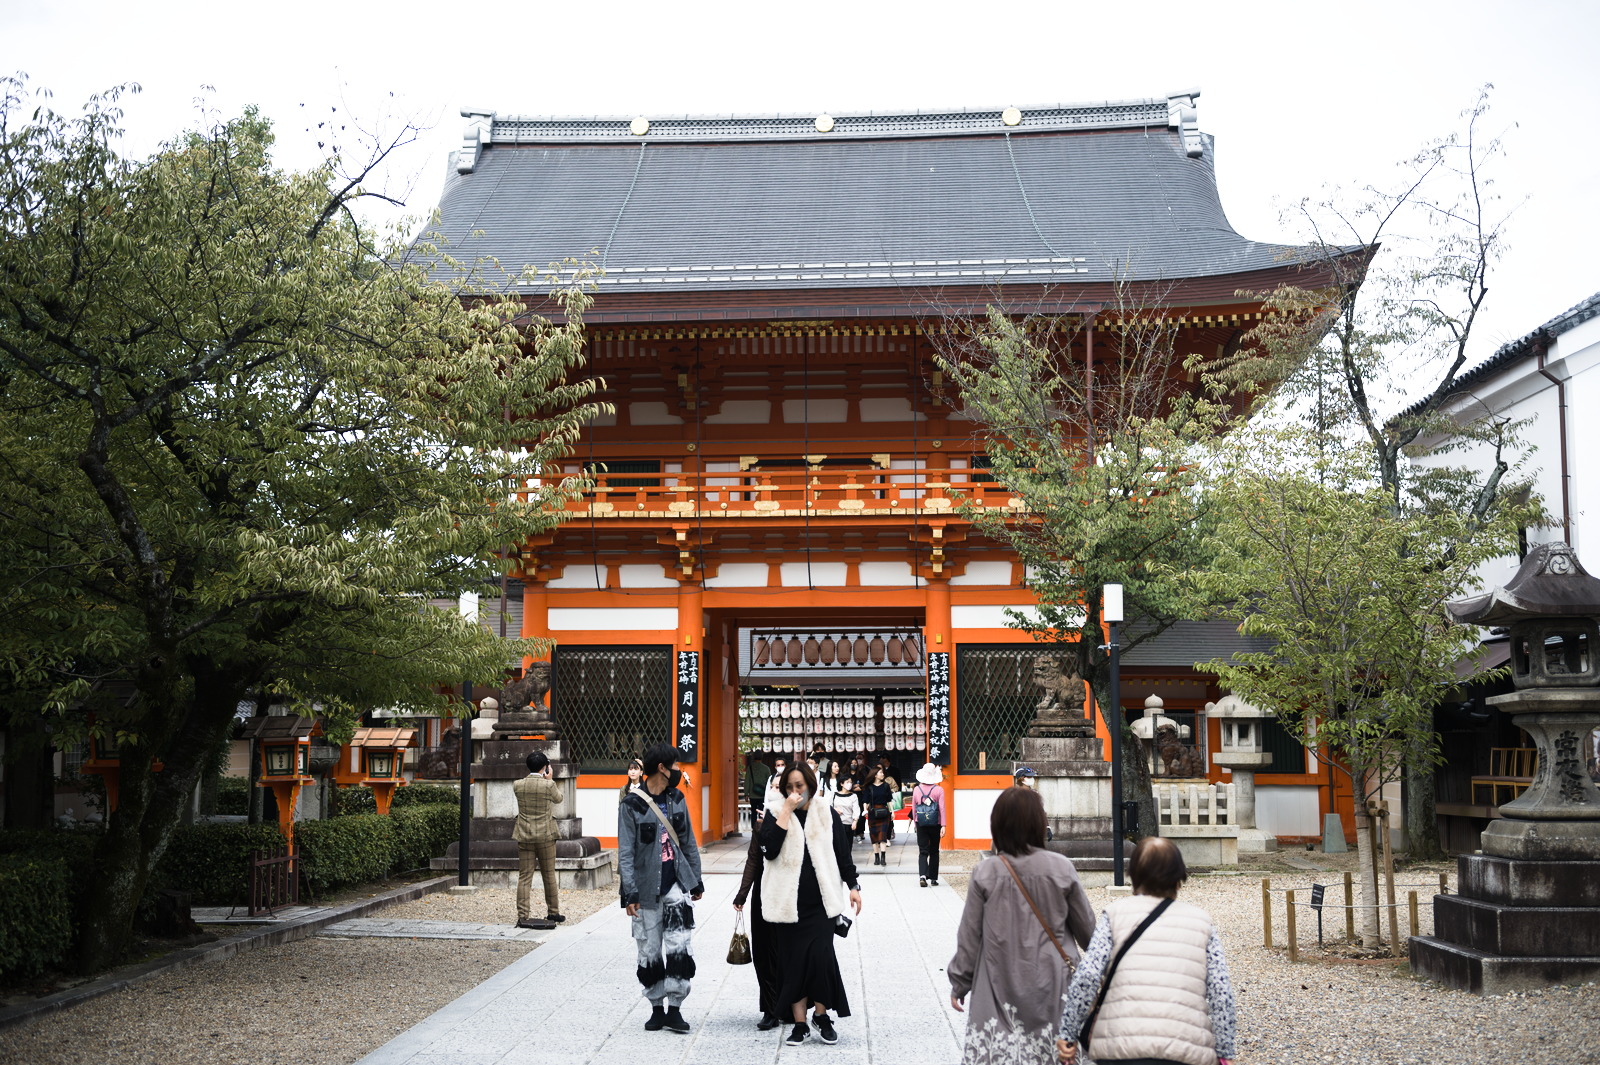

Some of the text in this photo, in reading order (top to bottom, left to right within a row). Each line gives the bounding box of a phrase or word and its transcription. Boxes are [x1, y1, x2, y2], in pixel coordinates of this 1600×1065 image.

[678, 651, 689, 685] 午前十時
[688, 651, 699, 684] 十月十五日
[929, 653, 940, 683] 午前十時
[678, 690, 697, 753] 月次祭
